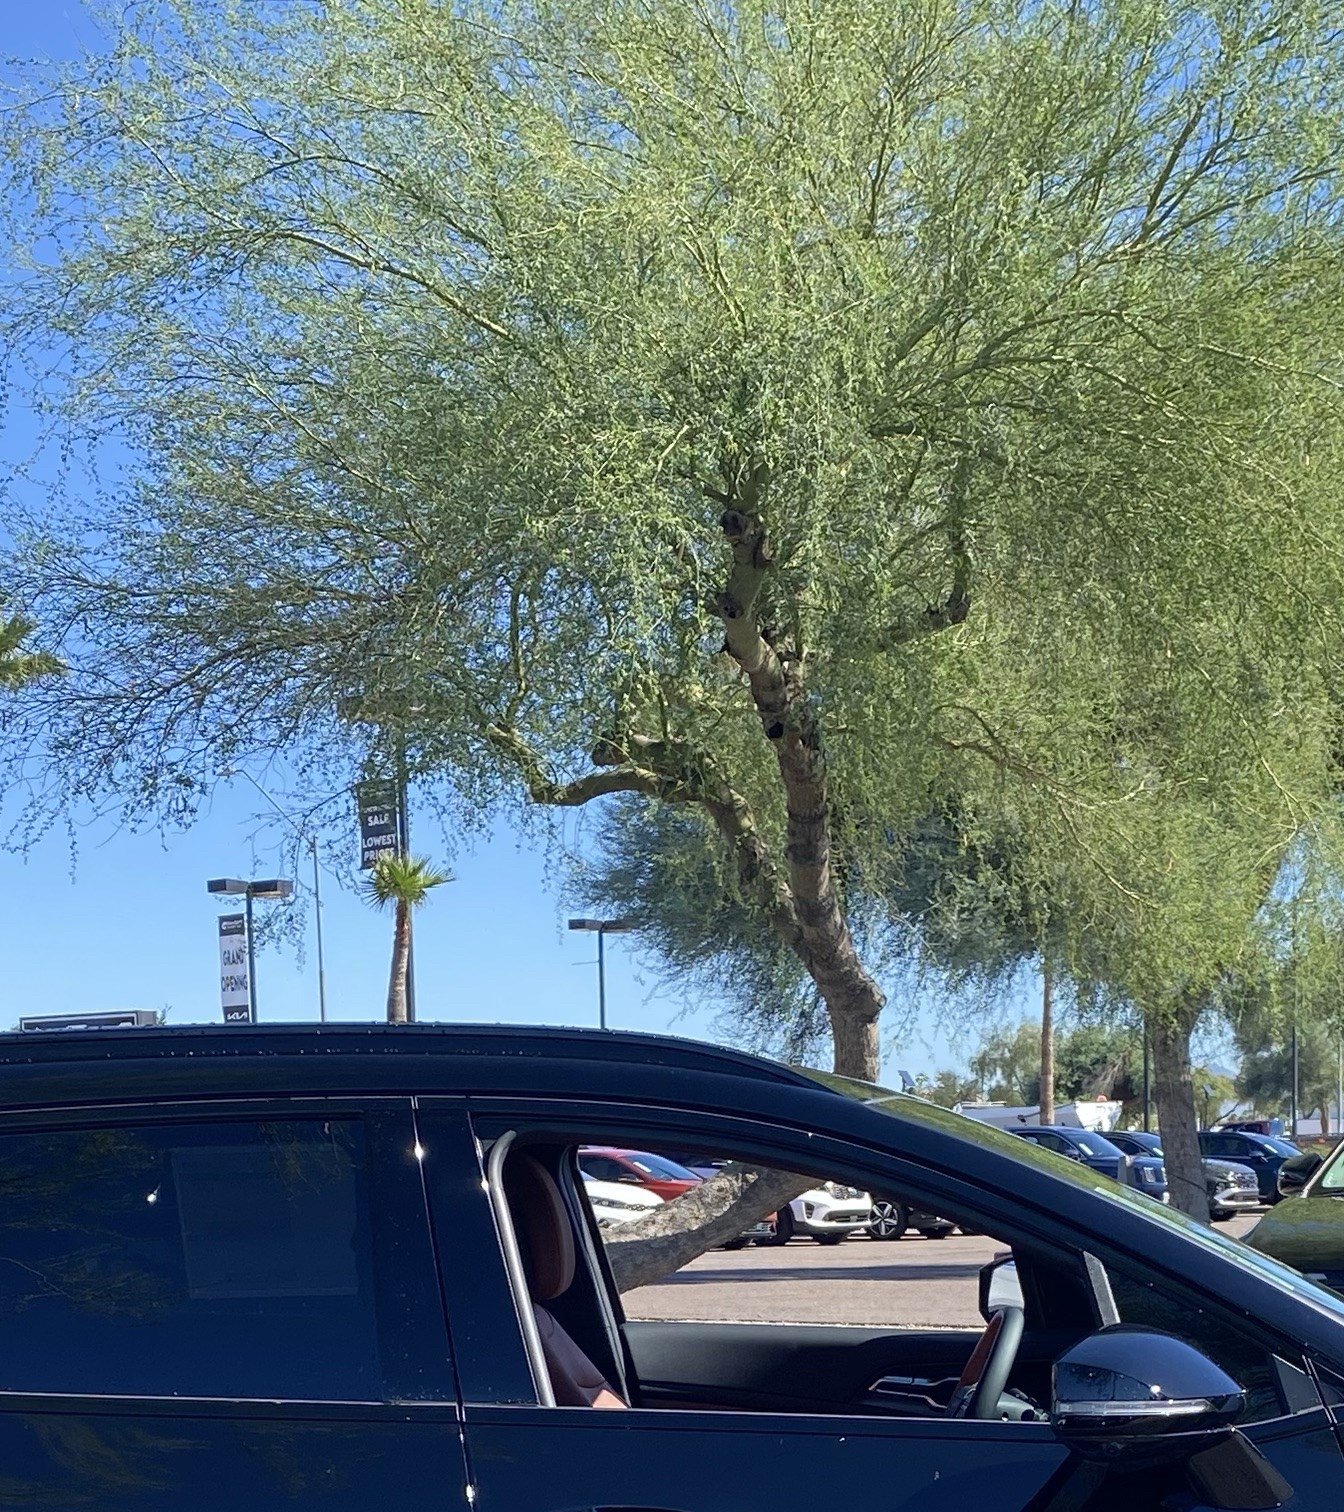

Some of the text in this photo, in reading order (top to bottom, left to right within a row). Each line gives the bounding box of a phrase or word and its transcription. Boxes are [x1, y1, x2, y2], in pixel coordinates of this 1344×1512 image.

[367, 813, 390, 827] SALE
[362, 833, 397, 849] LOWEST
[221, 974, 248, 992] OPENING
[226, 1011, 248, 1020] KIA
